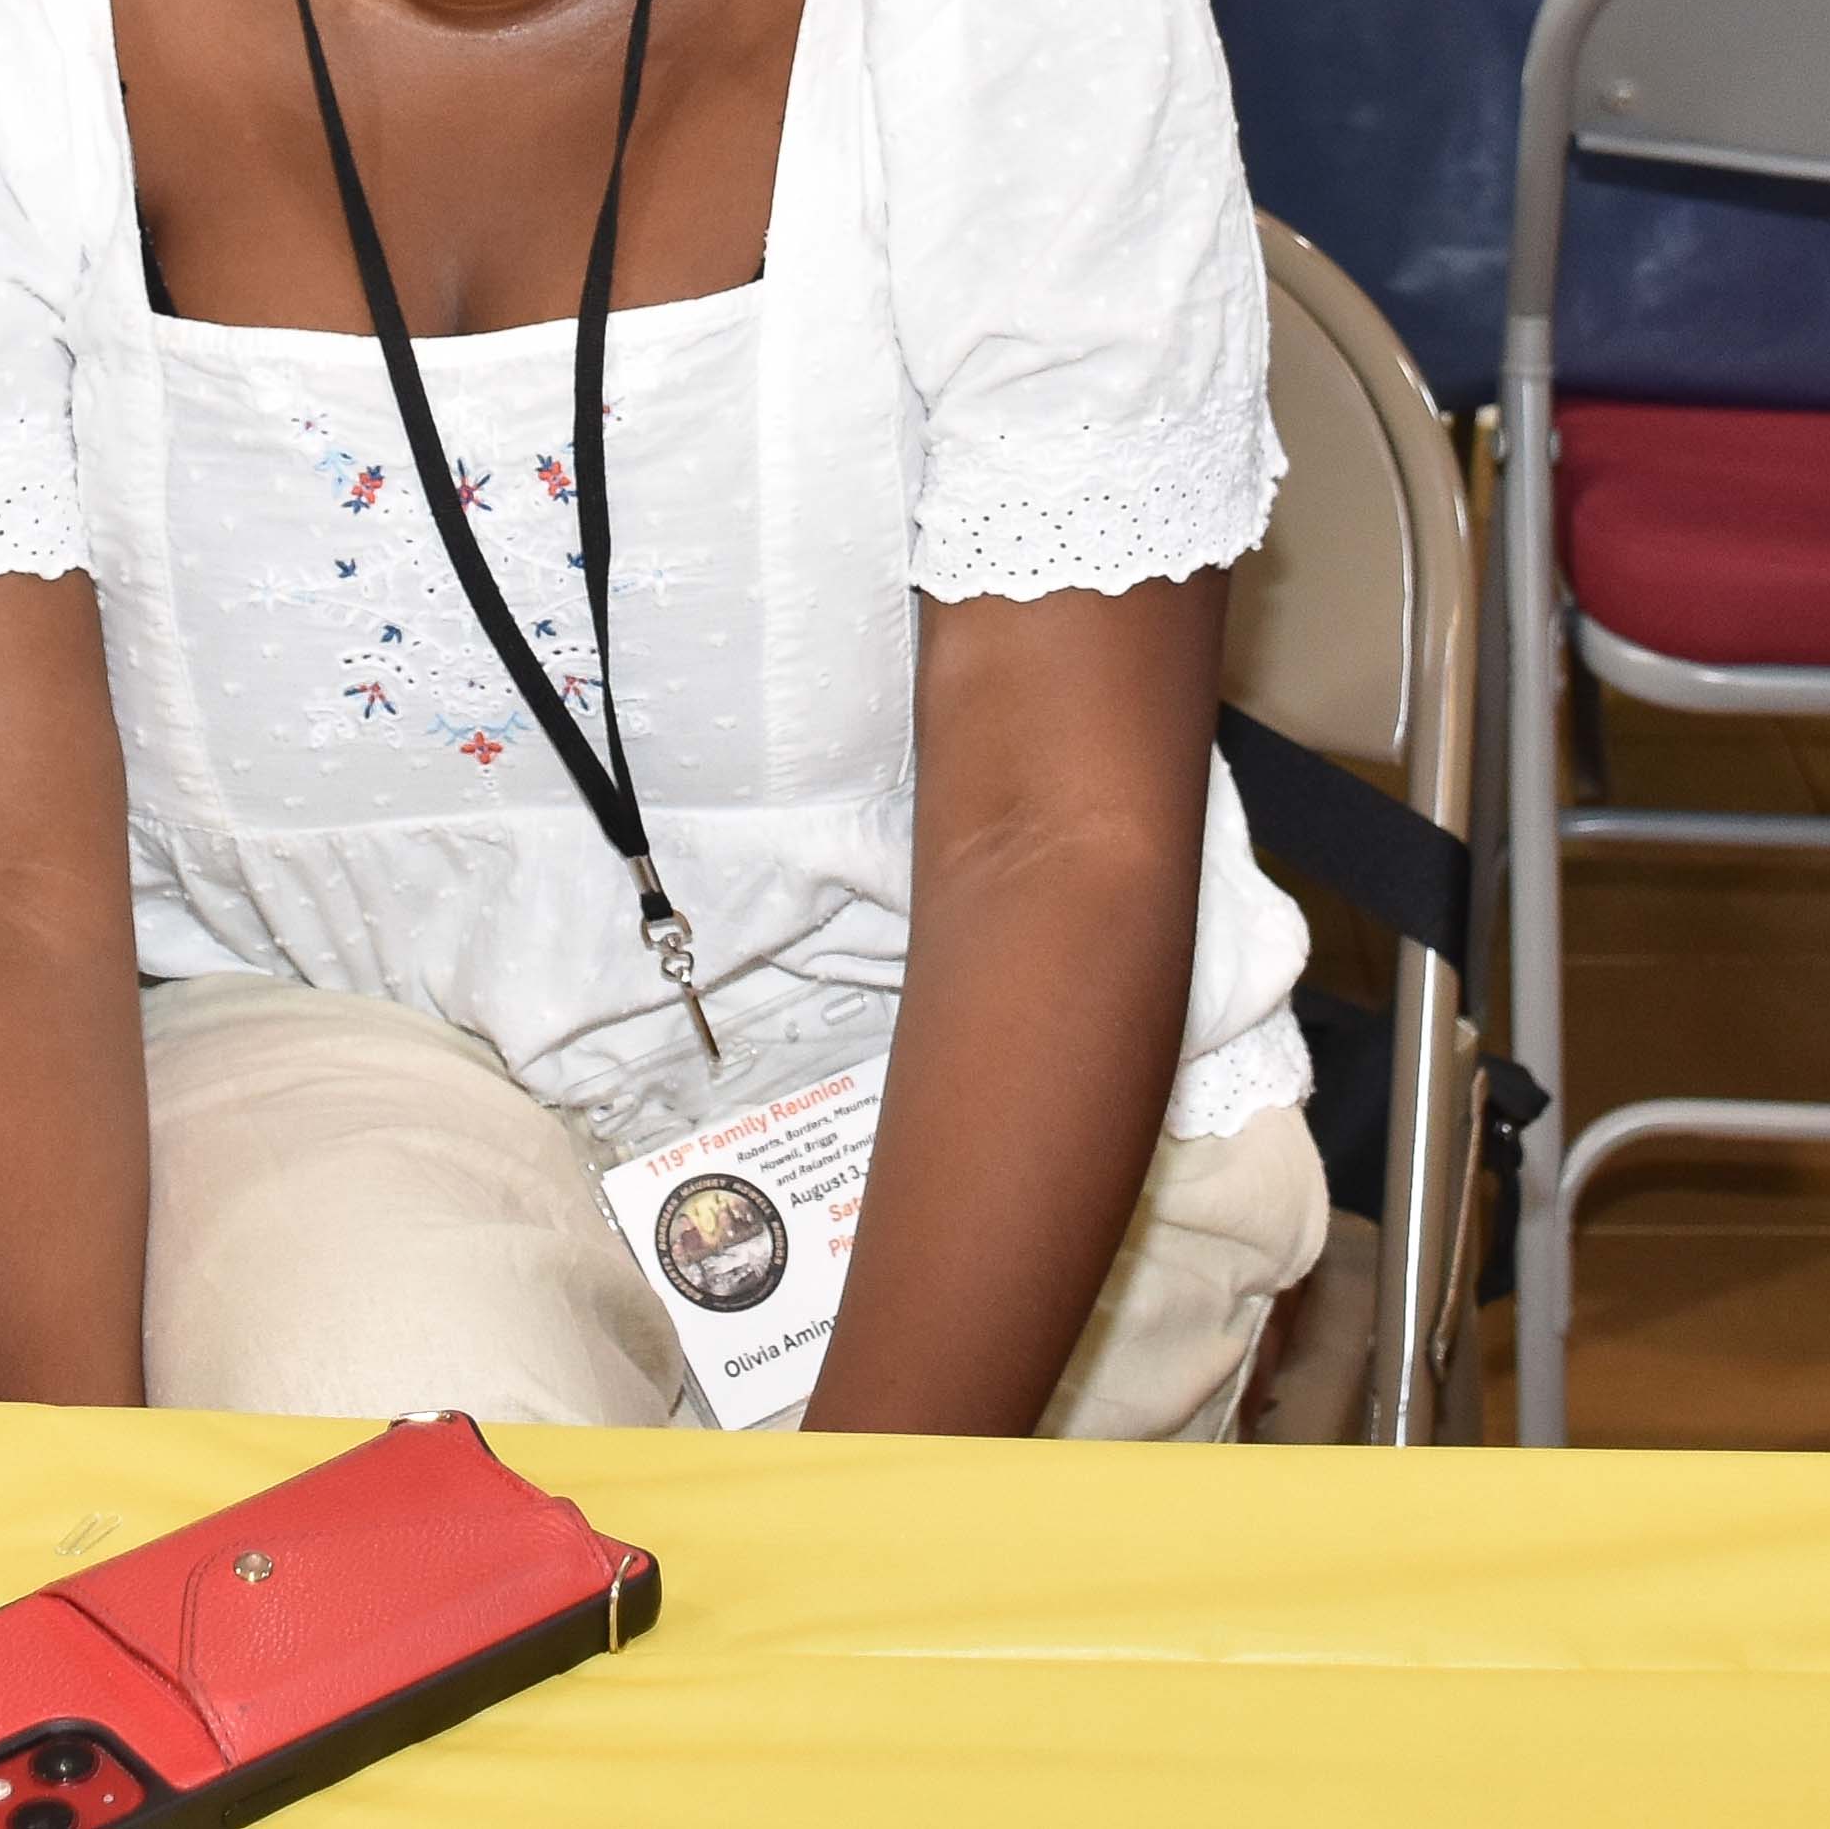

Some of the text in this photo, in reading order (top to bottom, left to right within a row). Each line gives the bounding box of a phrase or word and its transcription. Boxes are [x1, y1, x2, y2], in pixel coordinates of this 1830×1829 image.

[699, 1112, 768, 1155] Family
[769, 1074, 856, 1123] Reunion
[776, 1170, 797, 1186] and
[789, 1173, 847, 1208] August
[724, 1345, 781, 1378] Olivia
